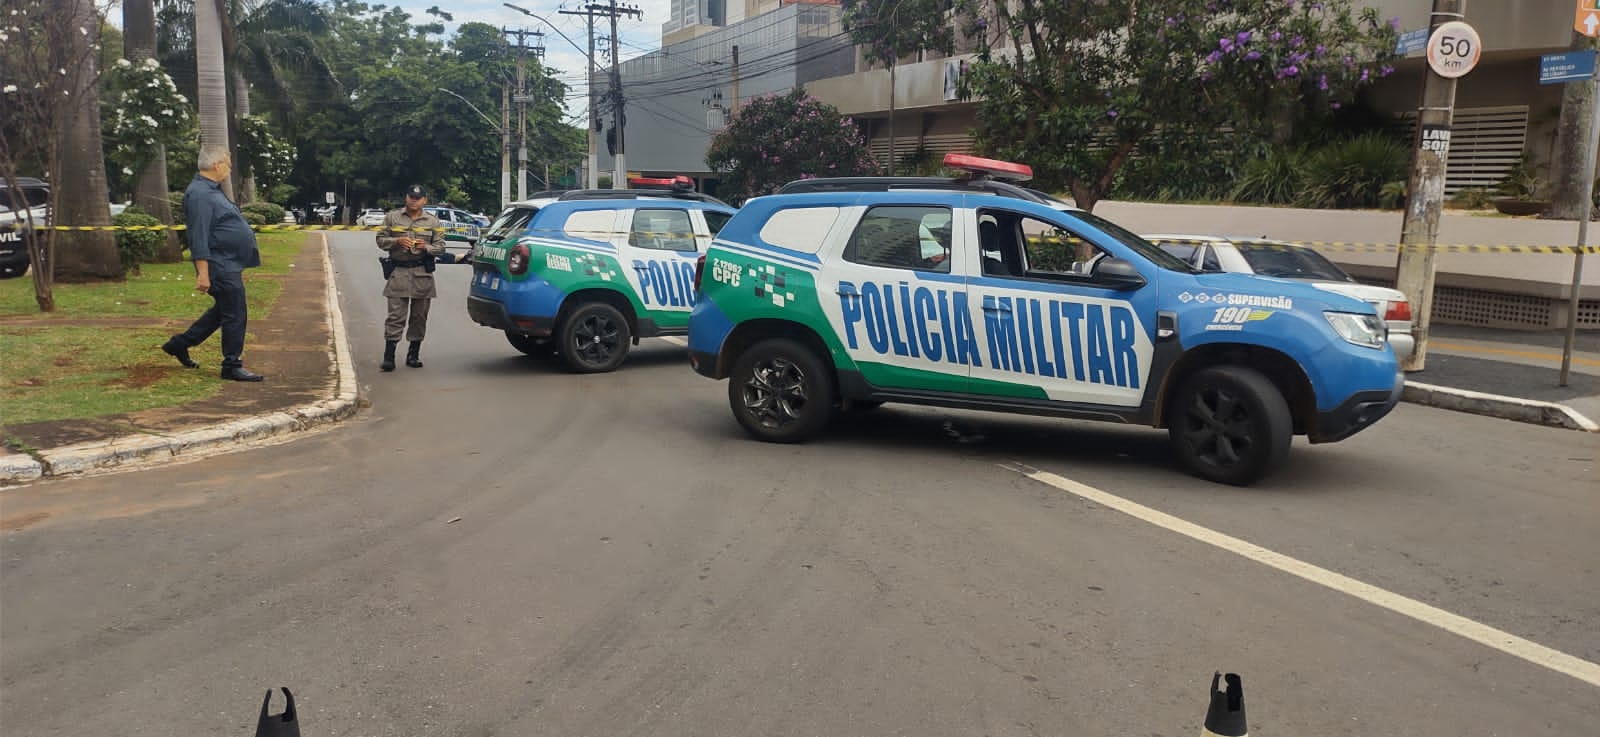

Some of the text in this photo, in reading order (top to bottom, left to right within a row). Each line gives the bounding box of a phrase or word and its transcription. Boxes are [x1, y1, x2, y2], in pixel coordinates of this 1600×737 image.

[1440, 36, 1470, 57] 50
[1444, 57, 1461, 67] km
[712, 266, 741, 287] CPC
[1228, 293, 1292, 310] SUPERVISÃO
[1212, 306, 1252, 324] 190
[838, 280, 1140, 390] POLÍCIA MILITAR
